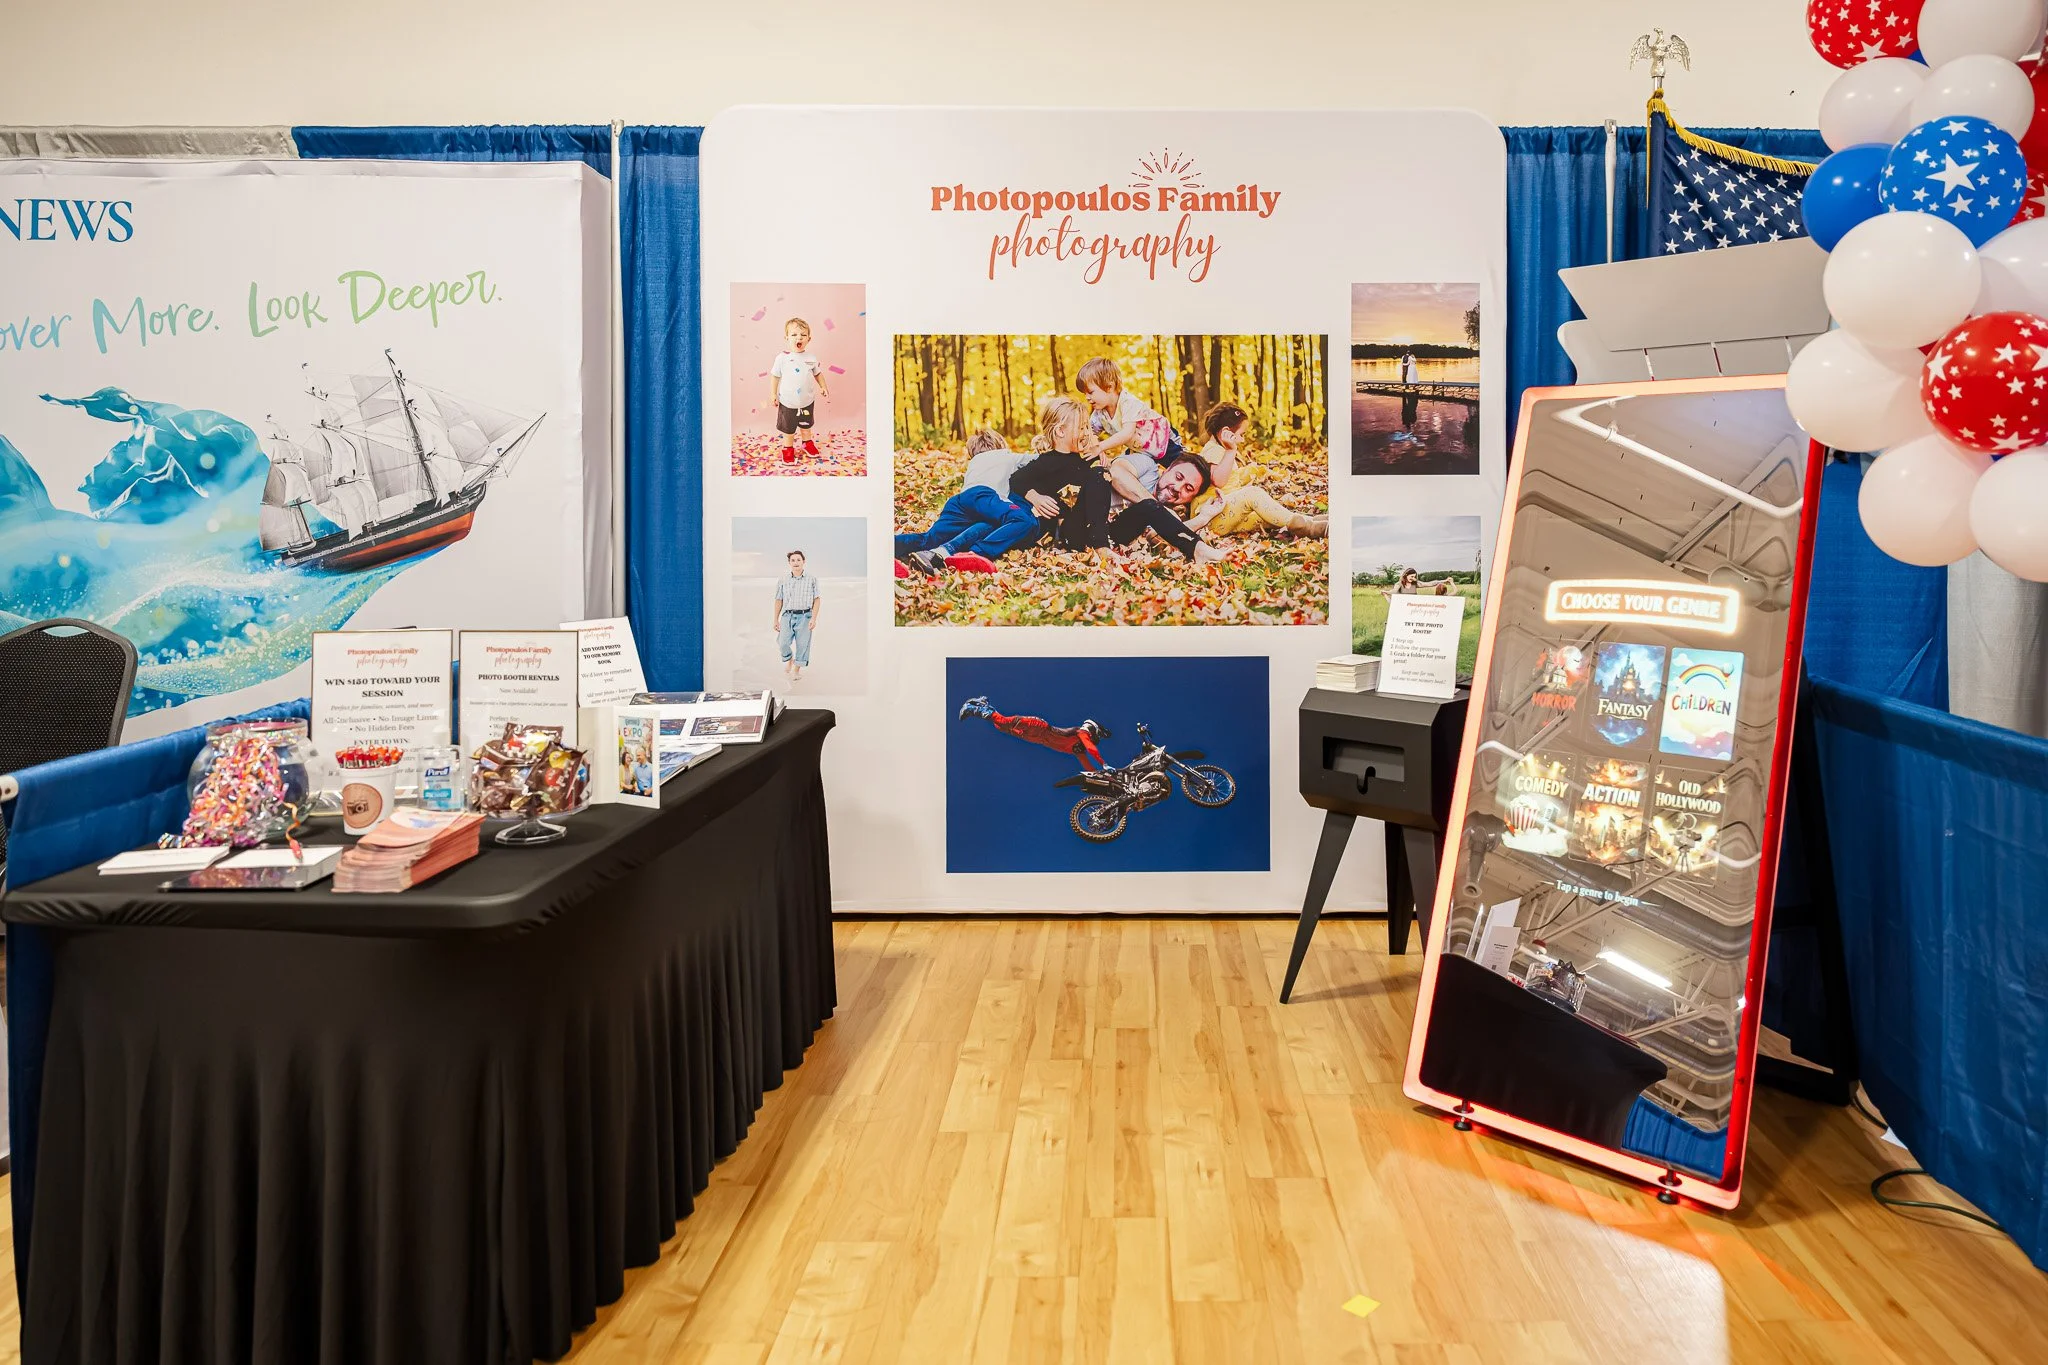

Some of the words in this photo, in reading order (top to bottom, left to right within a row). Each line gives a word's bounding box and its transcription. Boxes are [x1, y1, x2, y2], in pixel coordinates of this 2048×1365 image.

[930, 184, 1150, 218] Photopoulos
[1157, 184, 1281, 218] Family
[0, 199, 133, 242] NEWS
[988, 213, 1221, 285] photography
[93, 296, 220, 354] More.
[248, 281, 328, 337] Look
[337, 270, 502, 327] Deeper.
[1561, 592, 1622, 610] CHOOSE
[1624, 594, 1665, 612] YOUR
[1666, 596, 1722, 618] GENRE
[324, 678, 345, 686] WIN
[370, 677, 412, 685] TOWARD
[414, 676, 441, 684] YOUR
[362, 690, 404, 698] SESSION
[1531, 691, 1577, 712] HORROR
[1597, 698, 1652, 720] FANTASY
[623, 727, 643, 737] EXPO
[1514, 775, 1570, 799] COMEDY
[1582, 784, 1641, 809] ACTION
[1678, 780, 1702, 796] OLD
[1655, 792, 1722, 814] HOLLYWOOD
[1556, 879, 1572, 894] Tap
[1572, 885, 1578, 893] a
[1579, 886, 1603, 899] genre
[1604, 889, 1614, 901] to
[1614, 891, 1639, 907] begin
